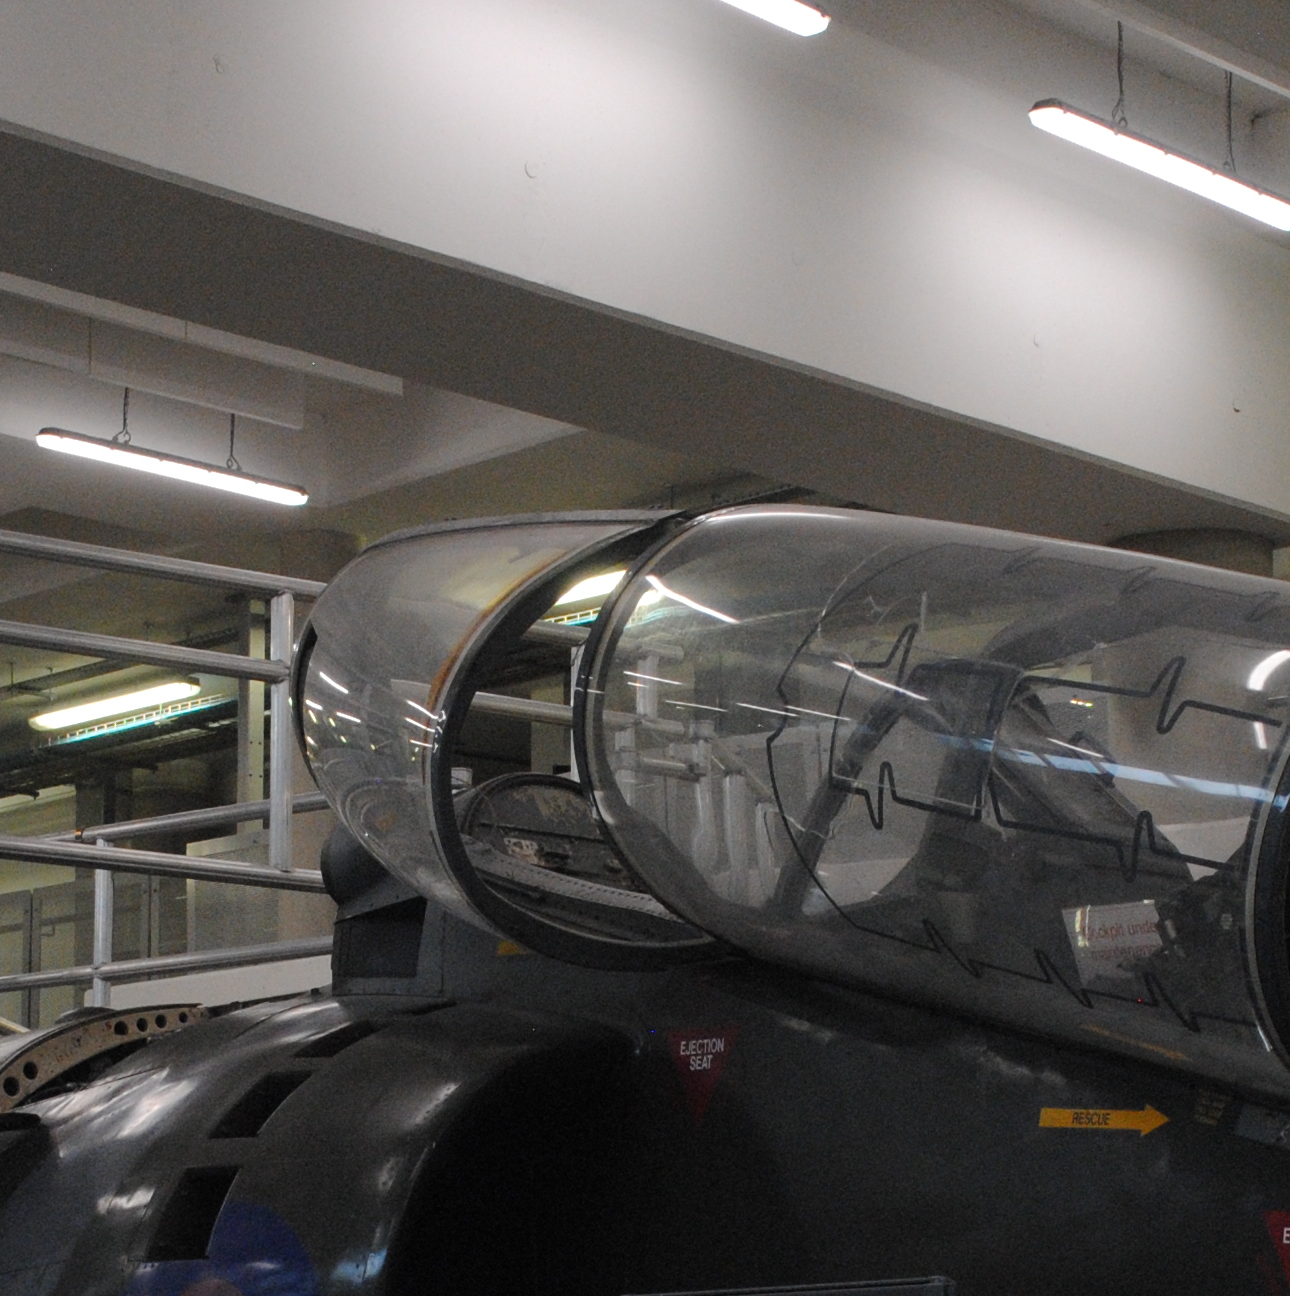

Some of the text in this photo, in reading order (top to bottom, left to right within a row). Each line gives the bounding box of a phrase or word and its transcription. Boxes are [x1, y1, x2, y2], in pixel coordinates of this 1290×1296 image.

[1128, 920, 1160, 936] unde
[680, 1037, 725, 1055] EJECTION
[690, 1054, 713, 1071] SEAT
[1071, 1111, 1110, 1126] RESCUE
